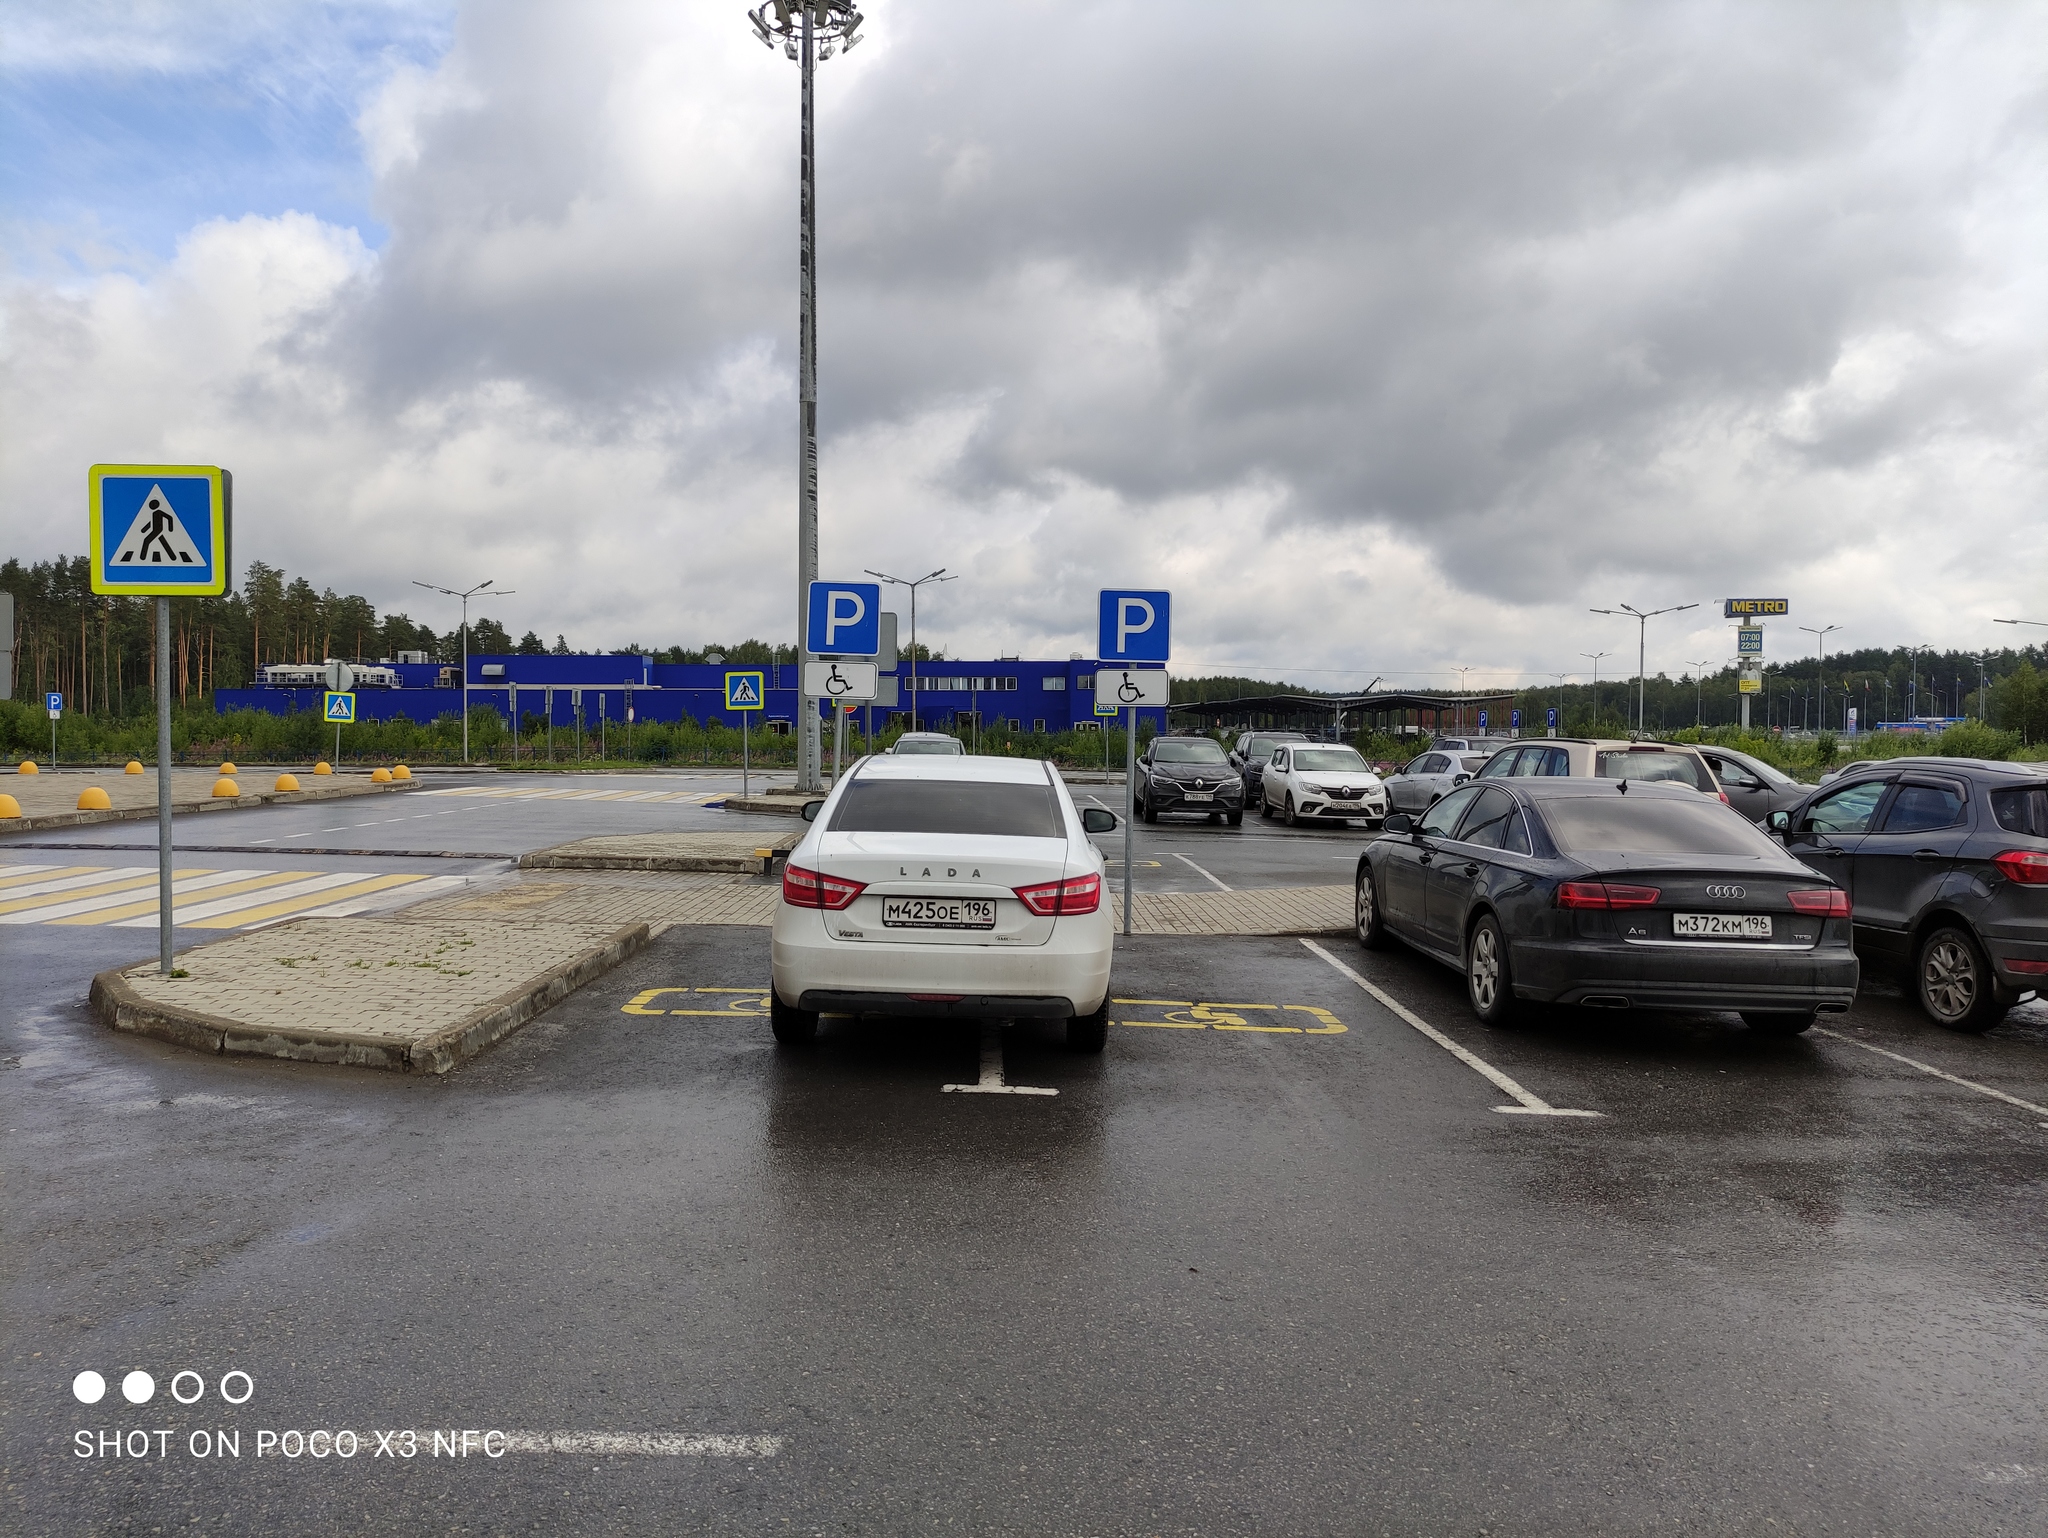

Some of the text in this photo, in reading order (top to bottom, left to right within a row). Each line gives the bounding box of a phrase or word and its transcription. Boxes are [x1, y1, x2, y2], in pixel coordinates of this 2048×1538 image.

[1731, 601, 1787, 612] METRO
[825, 590, 866, 646] P
[1115, 597, 1155, 653] P
[1740, 633, 1761, 641] 07:00
[1740, 641, 1761, 650] 22:00
[51, 695, 60, 709] P
[900, 867, 981, 879] LADA
[888, 901, 990, 920] М425ОЕ 196
[1627, 926, 1647, 936] A6
[1678, 916, 1767, 933] М372КМ 196
